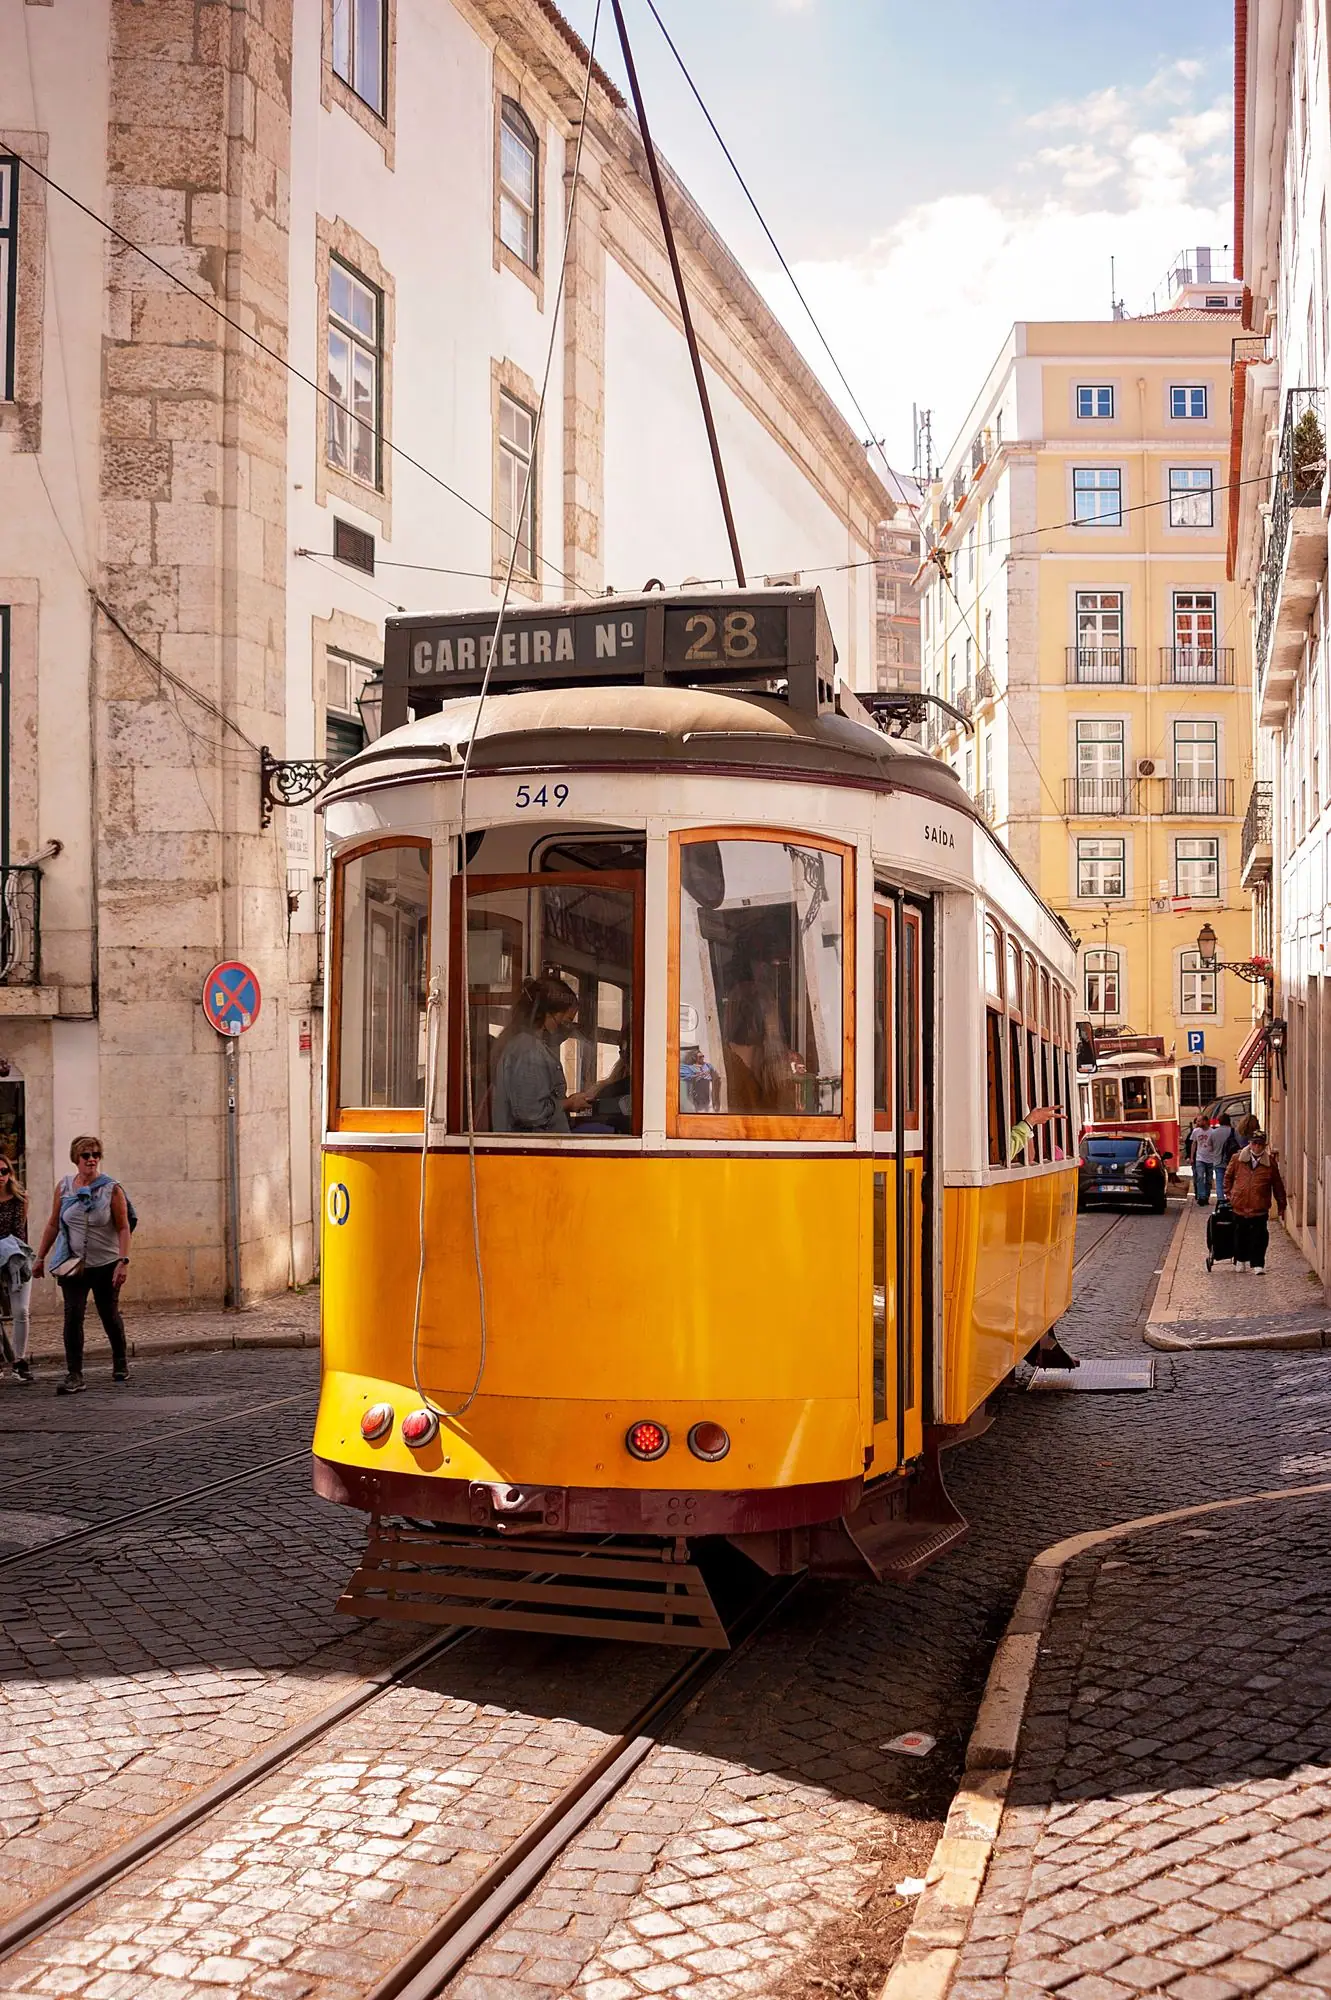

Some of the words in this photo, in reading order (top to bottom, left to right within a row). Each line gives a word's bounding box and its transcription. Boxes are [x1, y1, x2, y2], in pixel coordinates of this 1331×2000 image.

[684, 611, 758, 661] 28
[413, 628, 575, 674] CARREIRA
[515, 784, 570, 808] 549
[924, 825, 955, 849] SAÍDA
[1191, 1033, 1201, 1050] P
